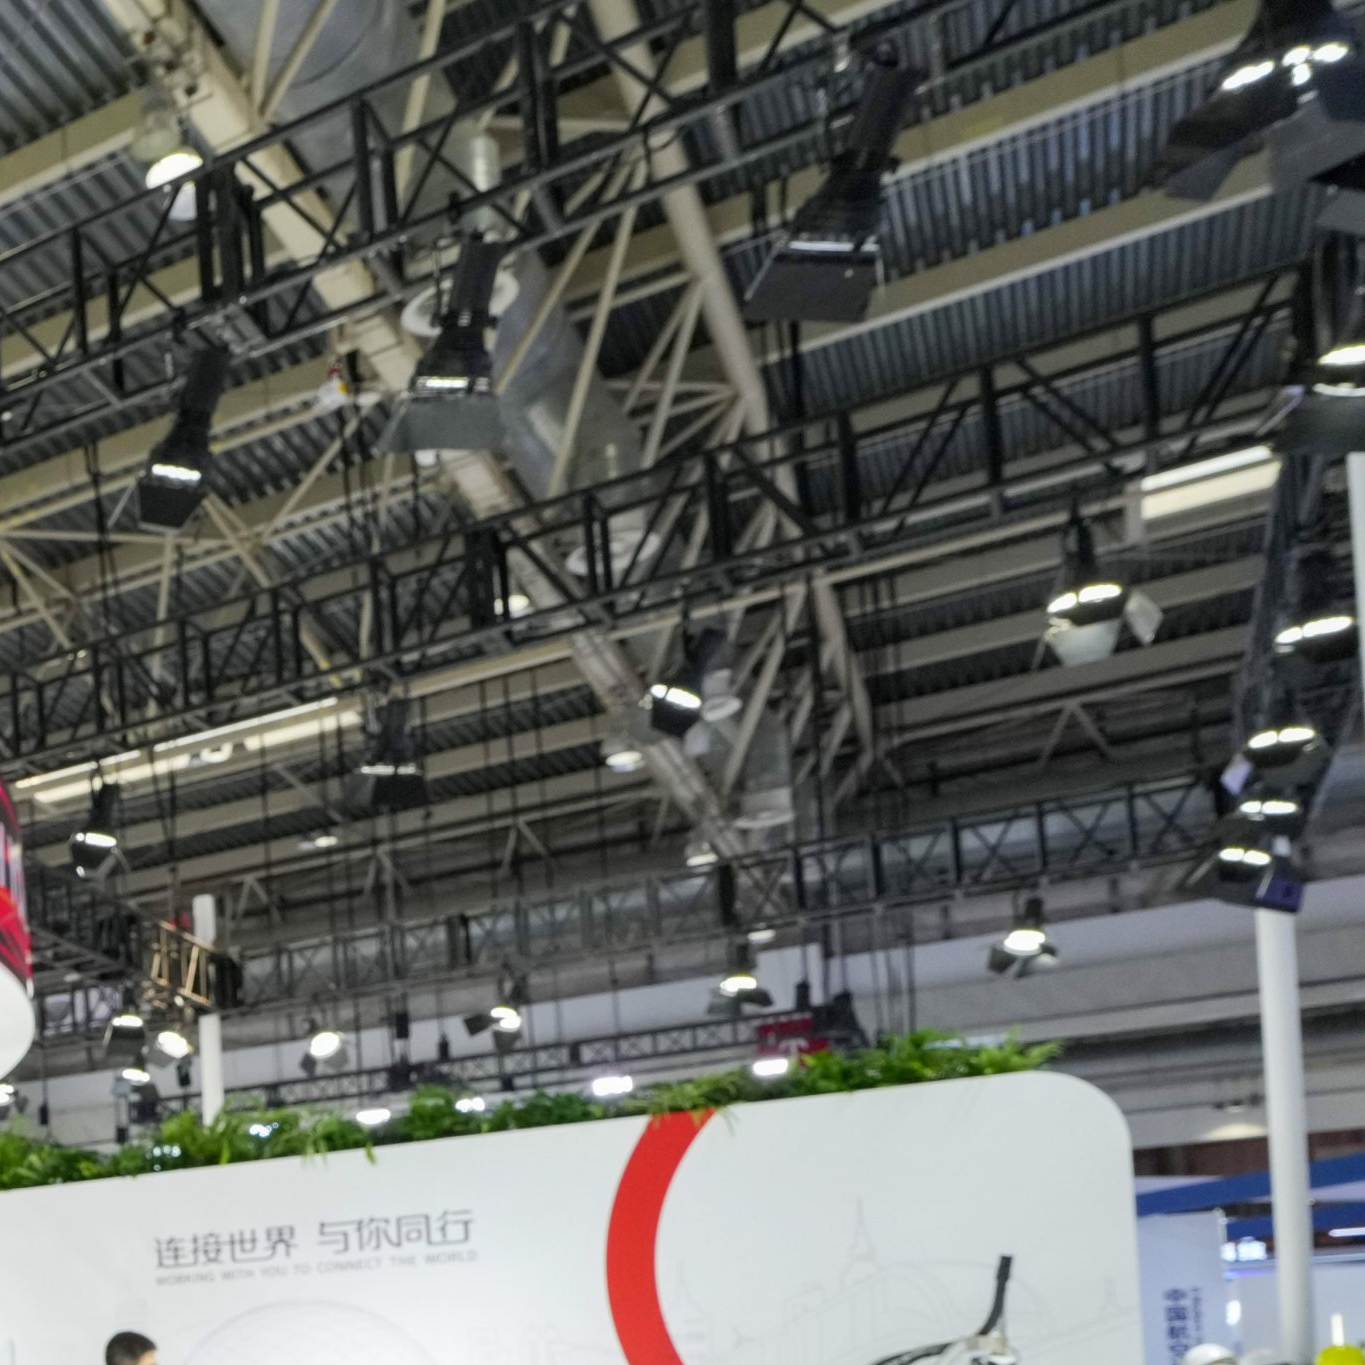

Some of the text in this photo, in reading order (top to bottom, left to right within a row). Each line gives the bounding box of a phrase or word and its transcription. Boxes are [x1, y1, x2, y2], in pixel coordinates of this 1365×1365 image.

[154, 1208, 475, 1270] 连接世界 与你同行
